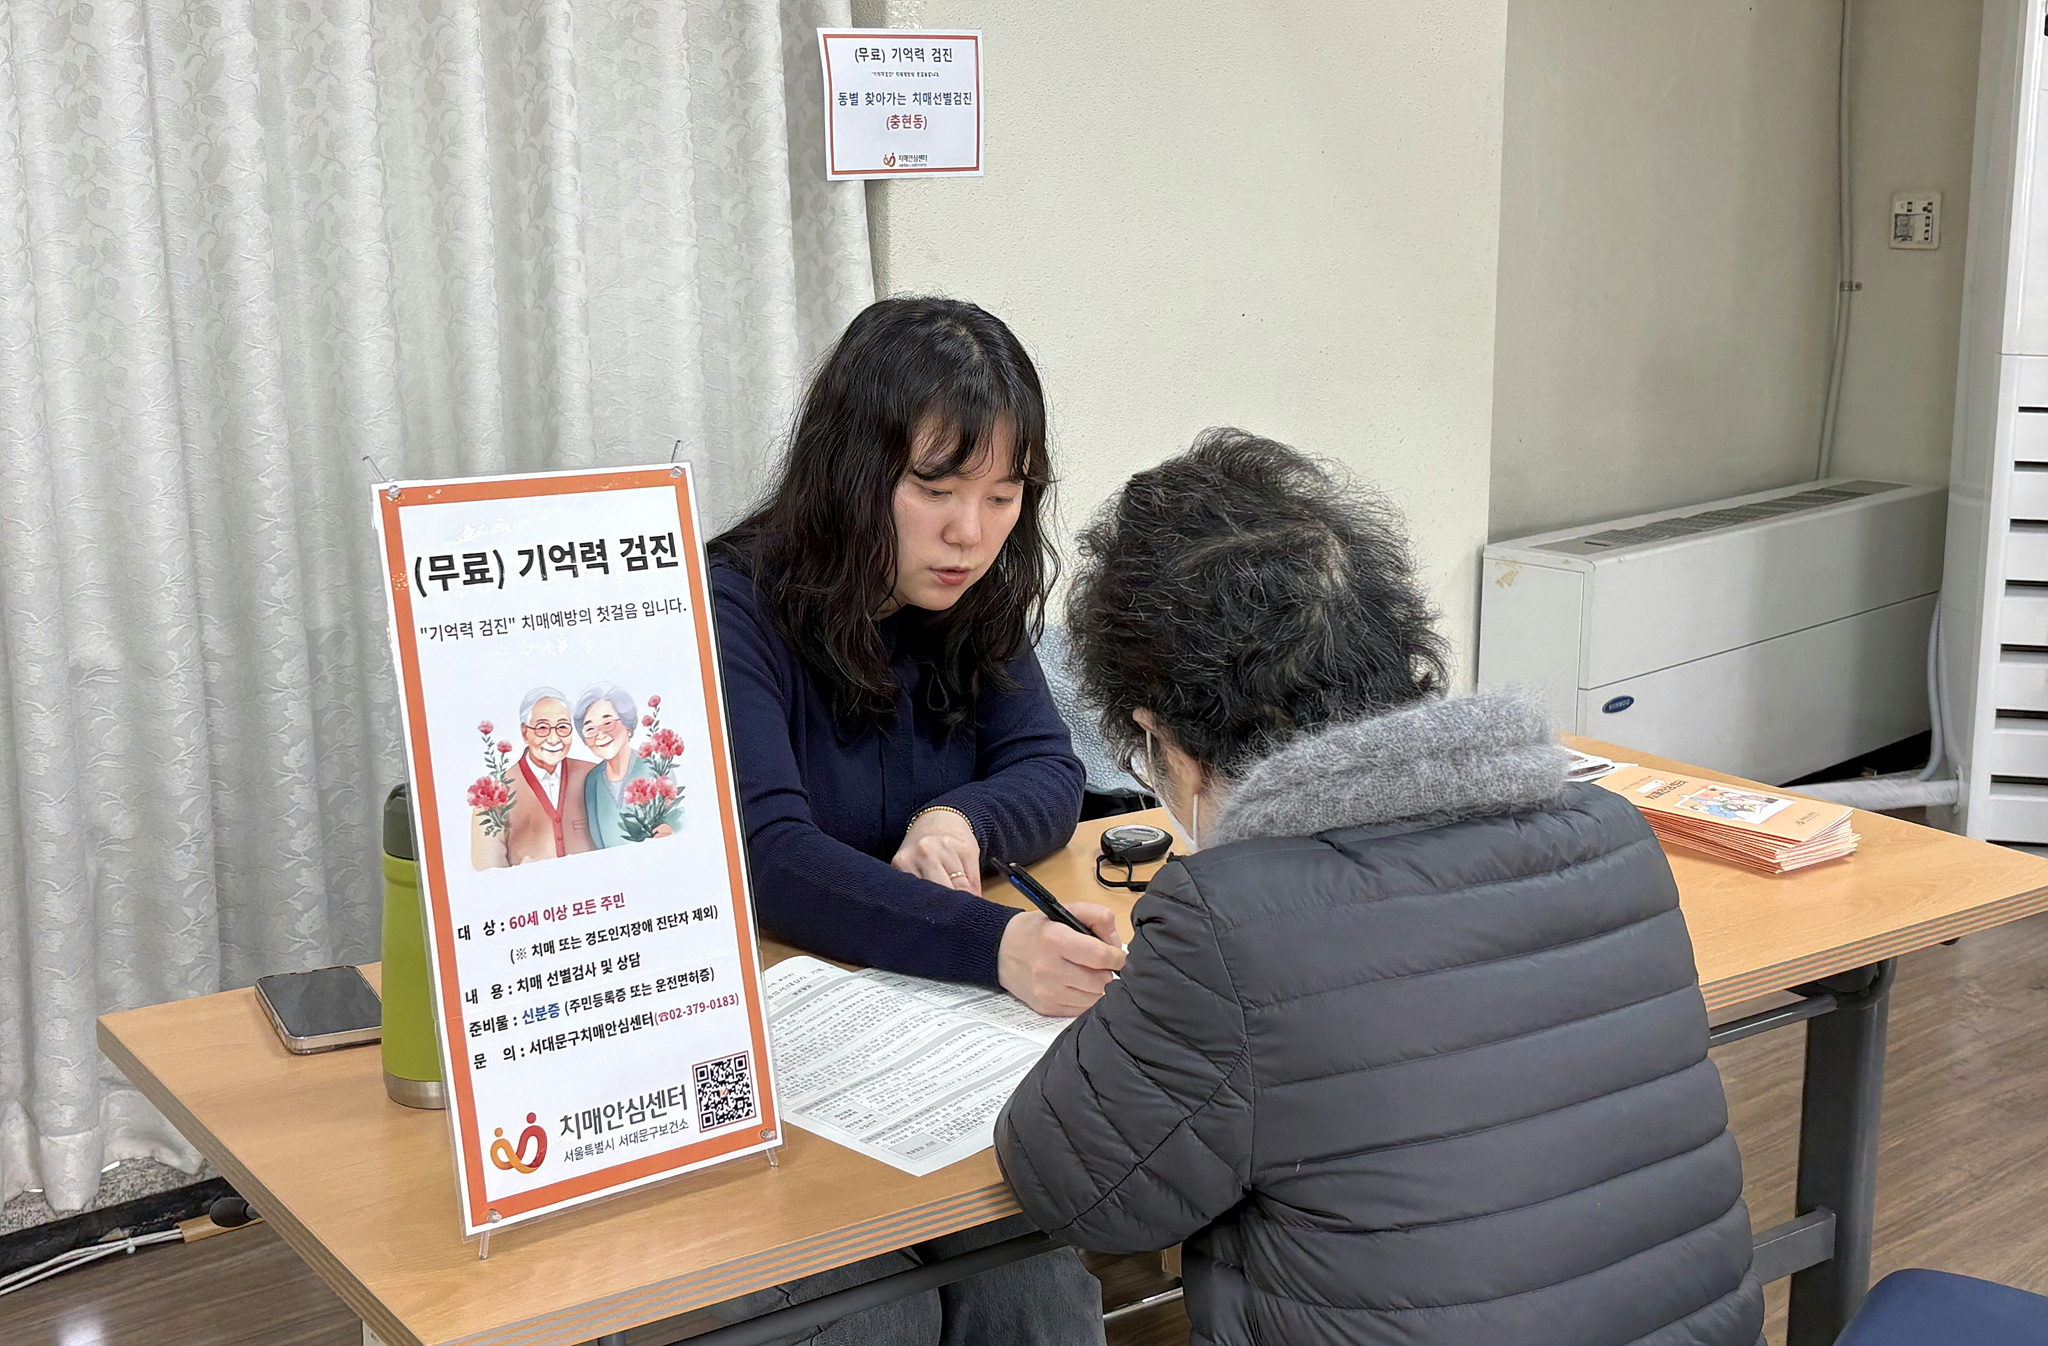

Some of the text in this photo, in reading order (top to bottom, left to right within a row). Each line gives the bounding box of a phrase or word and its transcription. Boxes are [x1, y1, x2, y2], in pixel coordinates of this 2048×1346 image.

[854, 47, 953, 63] (무료) 기억력 검진
[837, 92, 972, 107] 동별 찾아가는 치매선별검진
[886, 114, 928, 130] (충현동)
[414, 532, 679, 598] (무료) 기억력 검진
[420, 597, 687, 642] "기억력 검진" 치매예방의 첫걸음 입니다.
[509, 911, 539, 930] 60세
[543, 905, 568, 923] 이상
[572, 899, 597, 917] 모든
[600, 892, 625, 911] 주민
[532, 940, 555, 957] 치매
[559, 935, 582, 952] 또는
[585, 918, 653, 947] 경도인지장애
[656, 910, 689, 931] 진단자
[692, 905, 718, 922] 제외)
[516, 974, 543, 993] 치매
[546, 961, 597, 987] 선별검사
[600, 958, 613, 975] 및
[616, 952, 641, 972] 상담
[522, 1002, 561, 1025] 신분증
[564, 987, 626, 1017] (주민등록증
[630, 982, 652, 999] 또는
[655, 966, 715, 994] 운전면허증)
[559, 1084, 688, 1140] 치매안심센터
[563, 1118, 690, 1163] 서울특별시 서대문구보건소
